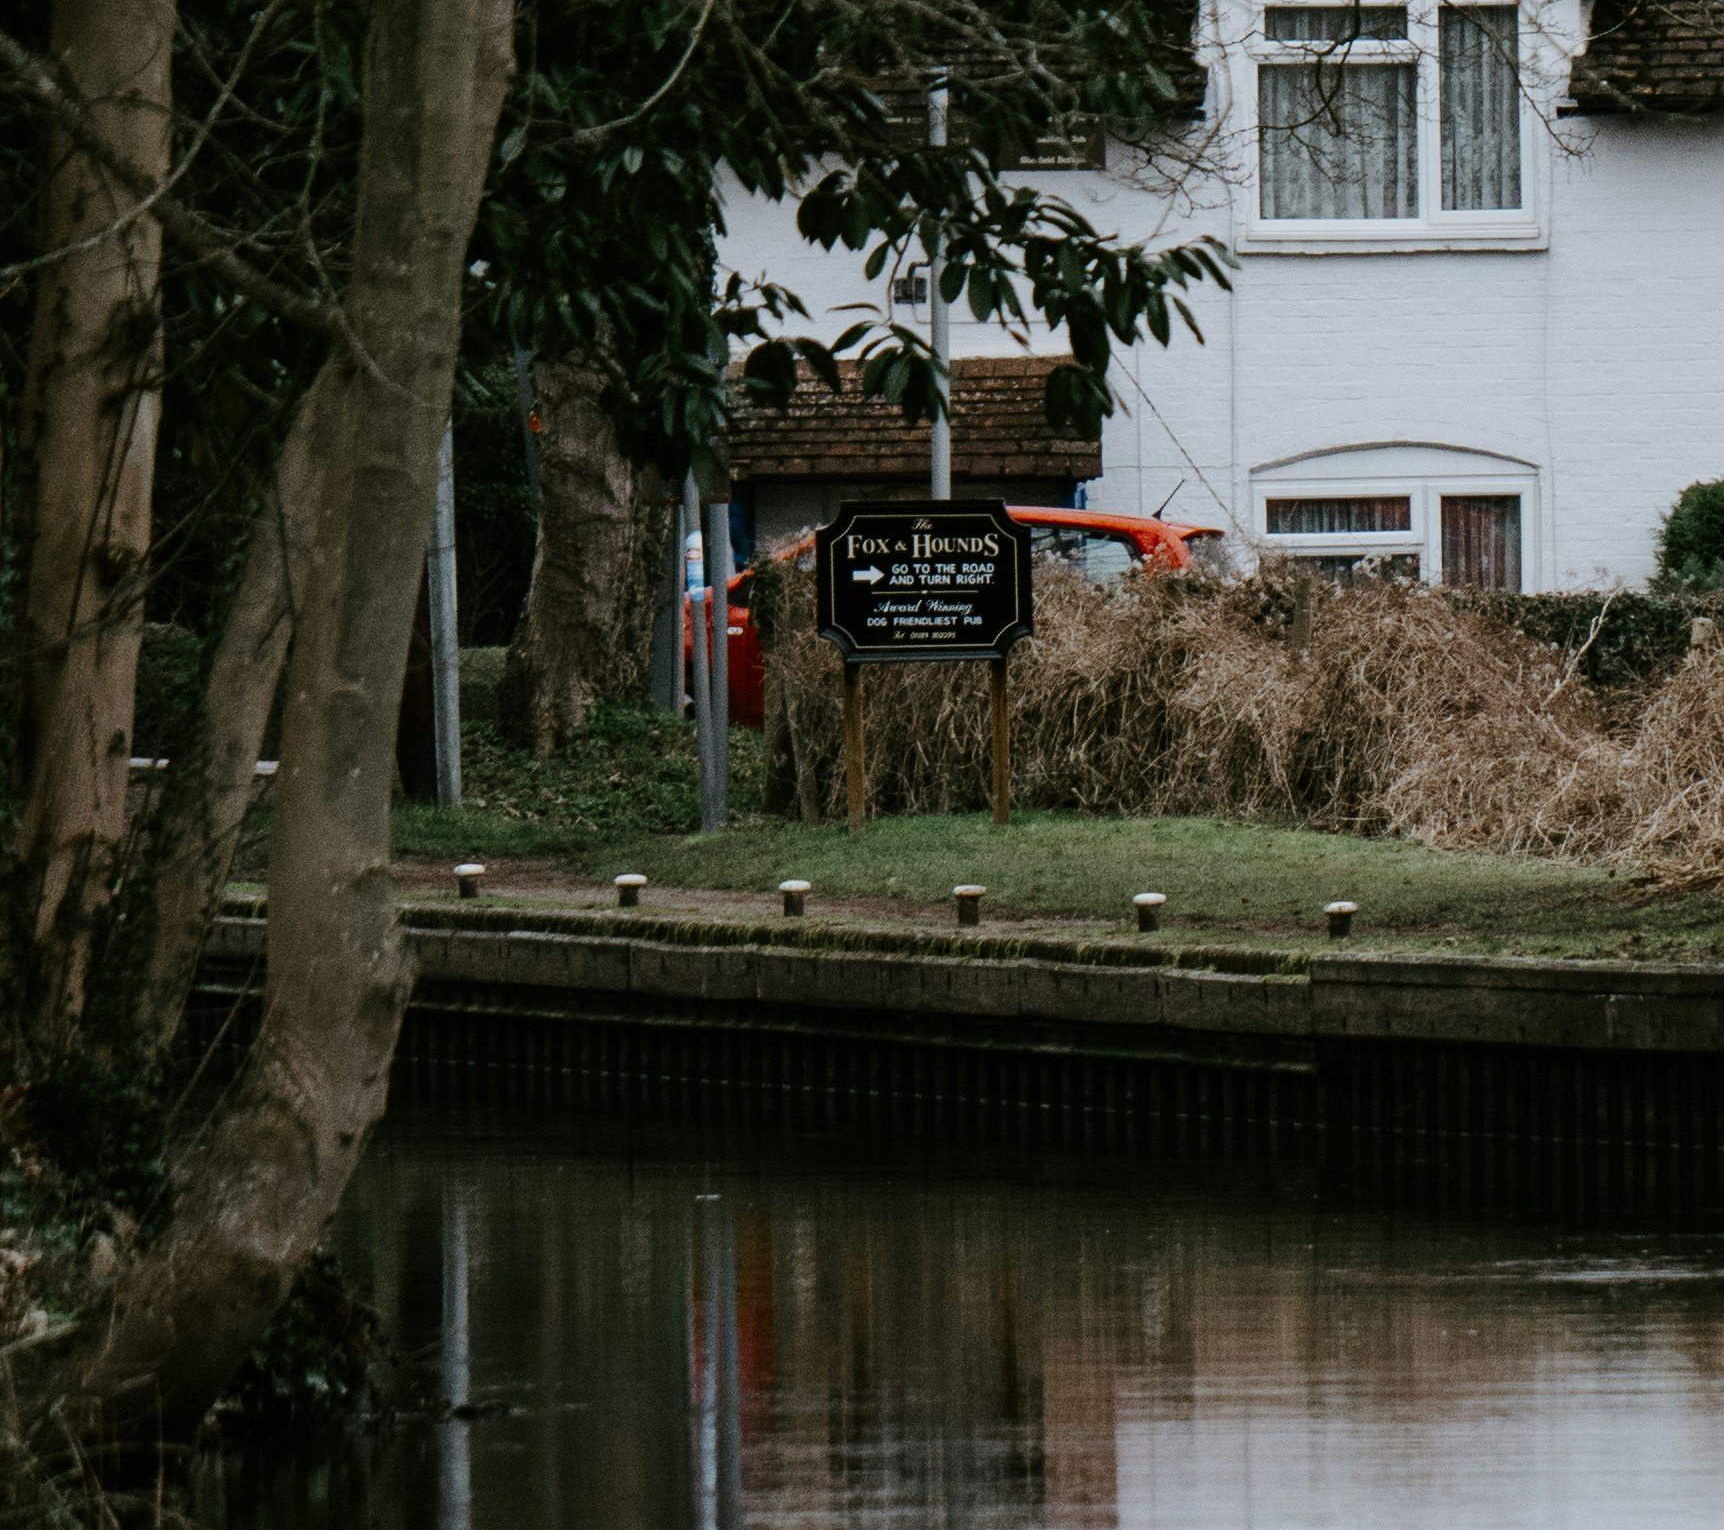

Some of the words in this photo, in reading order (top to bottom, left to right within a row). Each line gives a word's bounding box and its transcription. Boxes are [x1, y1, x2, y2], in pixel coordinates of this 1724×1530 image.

[911, 517, 934, 530] The
[846, 534, 891, 559] FOX
[894, 539, 909, 552] &
[911, 532, 1000, 559] HOUNDS
[891, 563, 909, 574] GO
[913, 563, 931, 574] TO
[935, 563, 957, 574] THE
[962, 562, 995, 573] ROAD
[889, 574, 915, 585] AND
[918, 574, 951, 585] TURN
[955, 573, 995, 585] RIGHT.
[873, 599, 923, 613] Award
[925, 599, 974, 616] Winning
[866, 617, 888, 627] DOG
[893, 616, 958, 626] FRIENDLIEST
[963, 616, 983, 625] PUB
